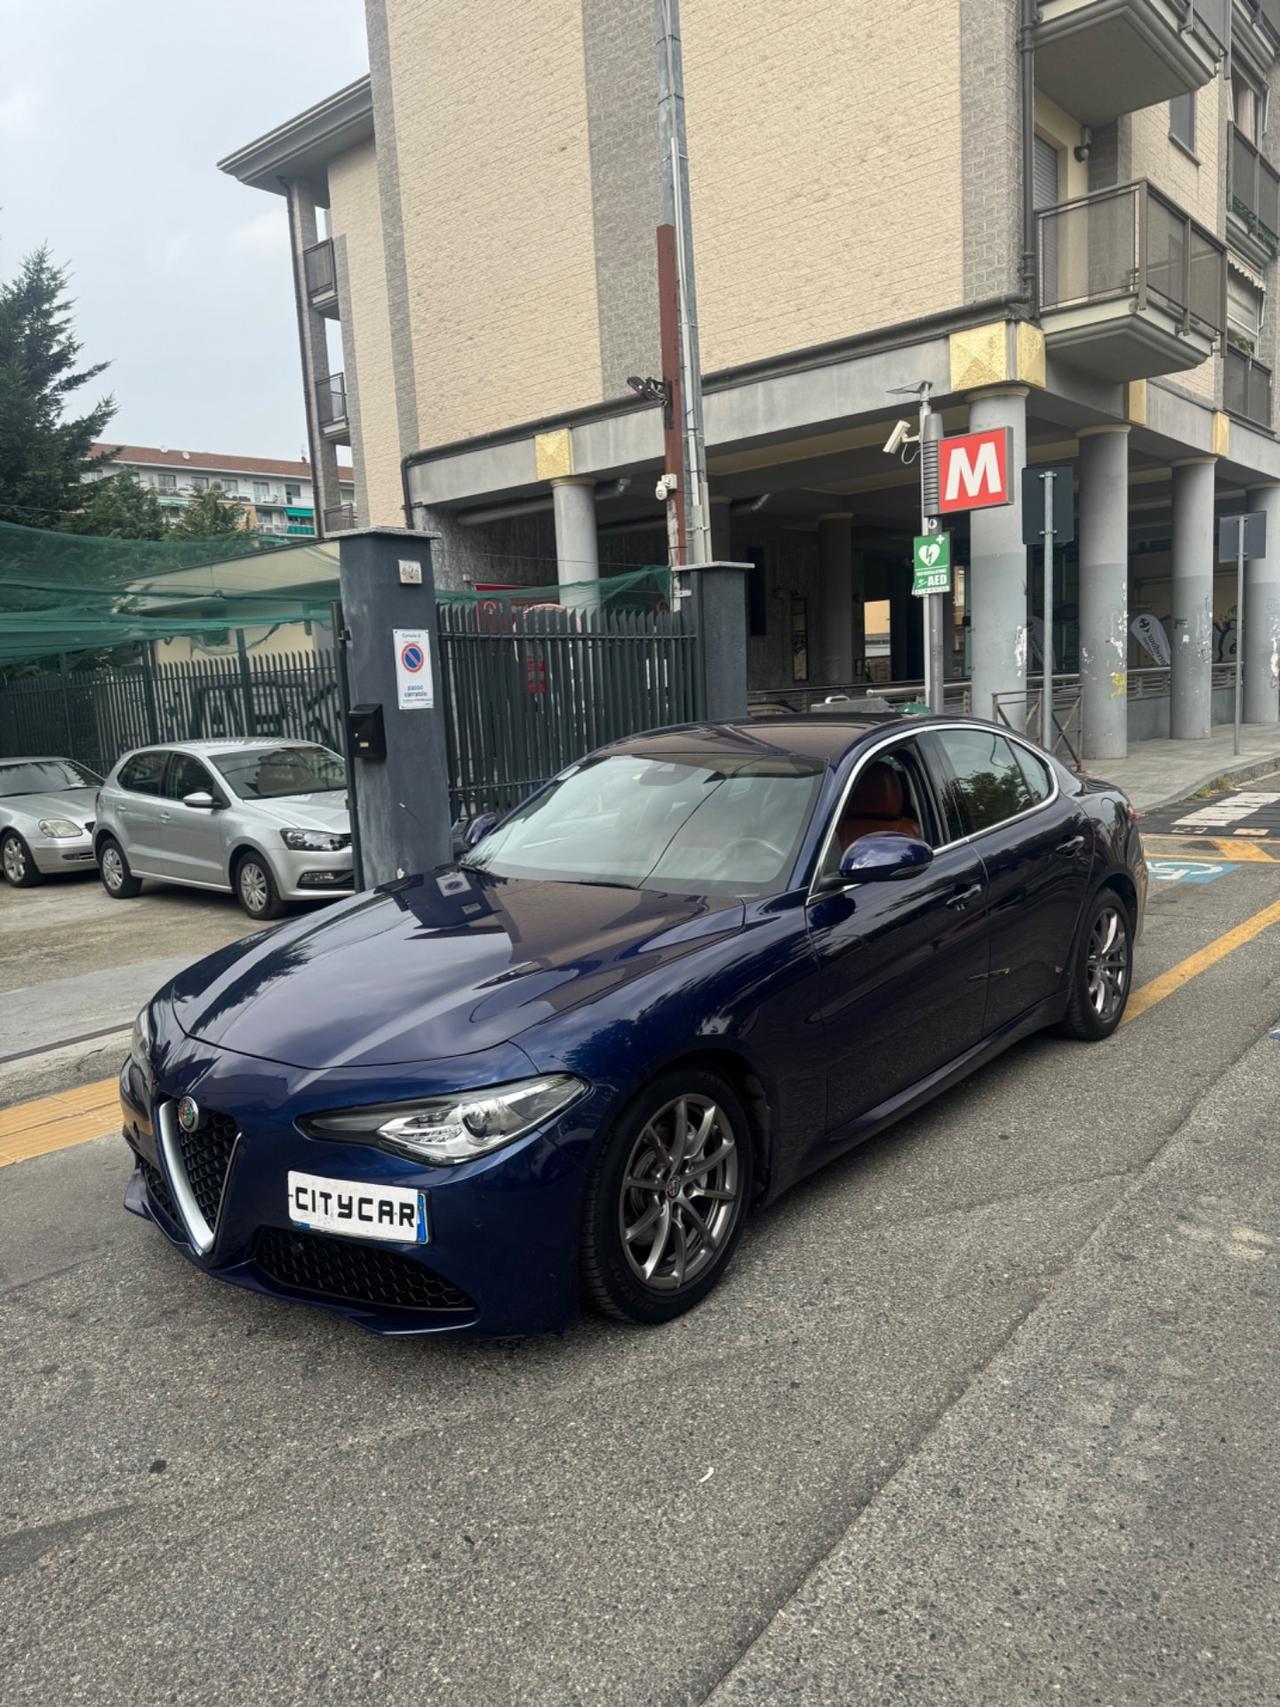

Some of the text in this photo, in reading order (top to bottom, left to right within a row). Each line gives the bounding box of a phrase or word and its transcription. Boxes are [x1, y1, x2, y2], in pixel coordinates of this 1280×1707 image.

[945, 441, 1002, 500] M
[927, 574, 947, 586] AED
[295, 1186, 415, 1228] CITYCAR
